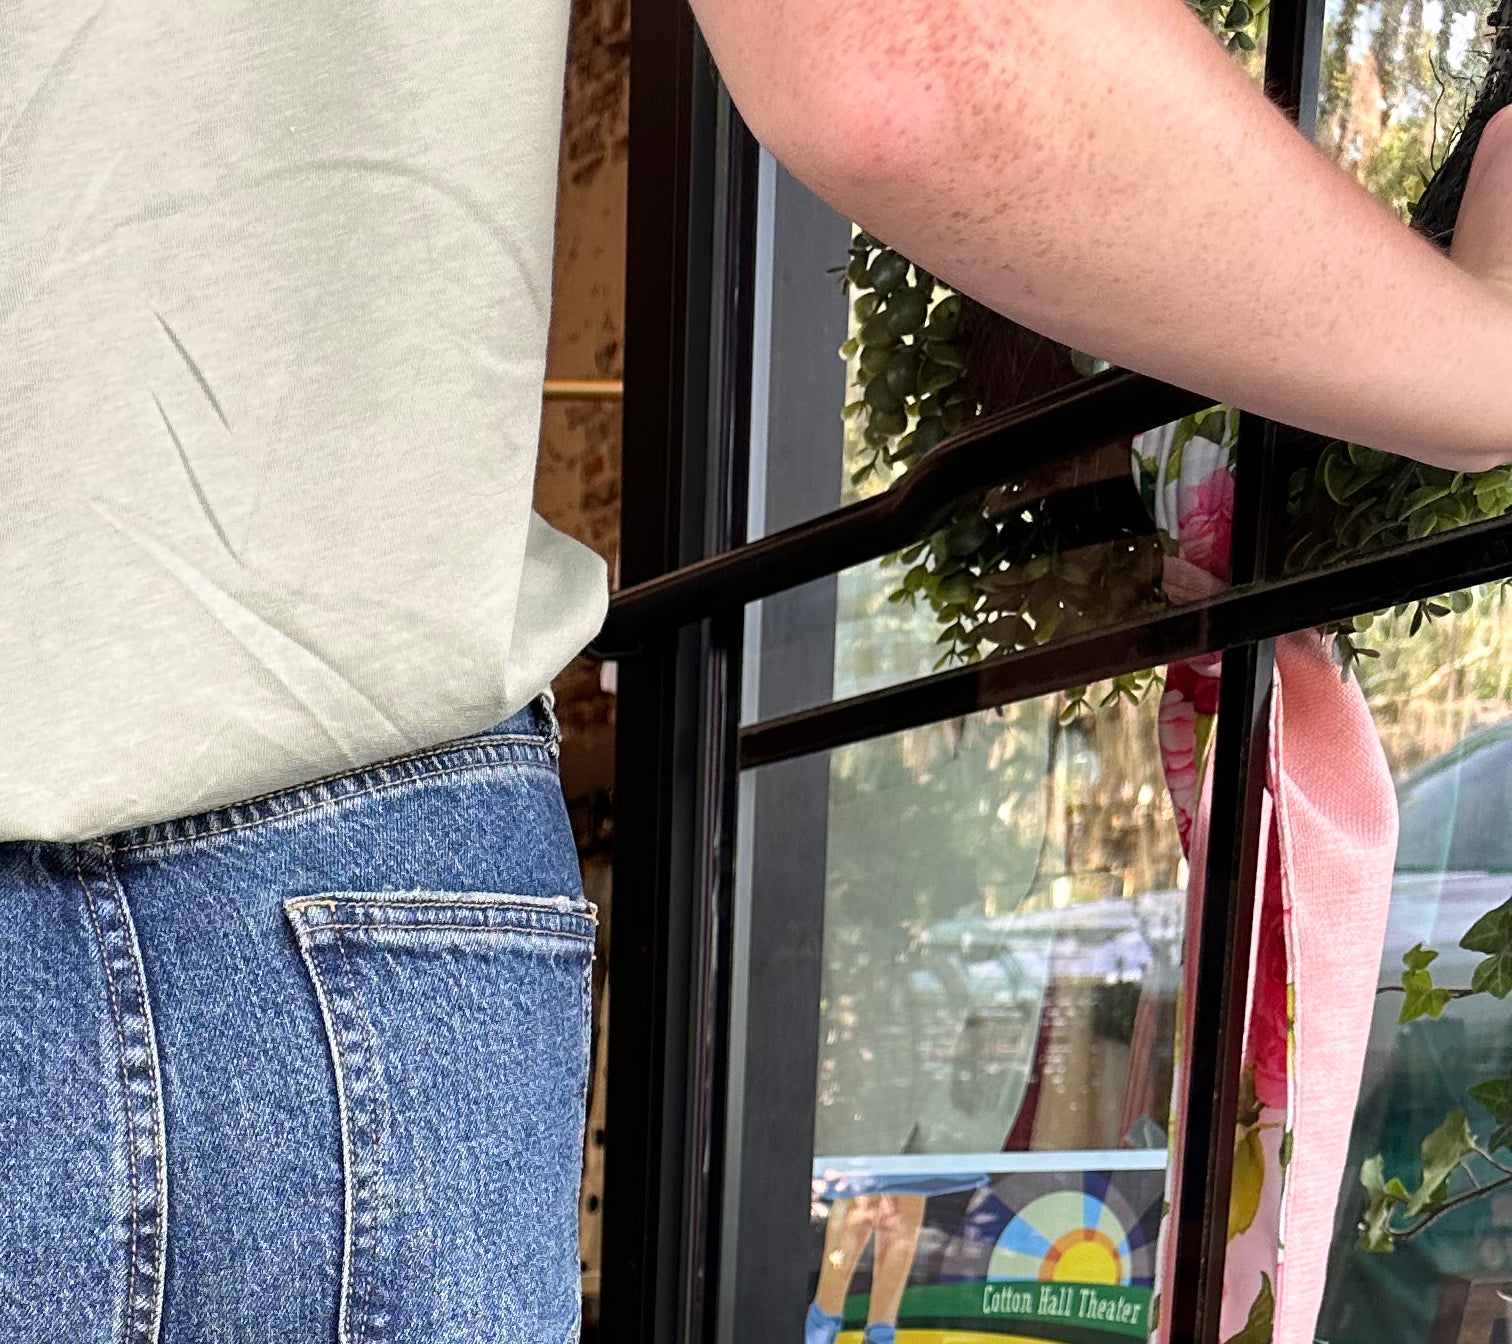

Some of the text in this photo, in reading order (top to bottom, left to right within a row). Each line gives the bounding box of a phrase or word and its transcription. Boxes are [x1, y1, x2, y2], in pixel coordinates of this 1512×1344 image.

[982, 1284, 1143, 1325] Cotton Hall Theater
